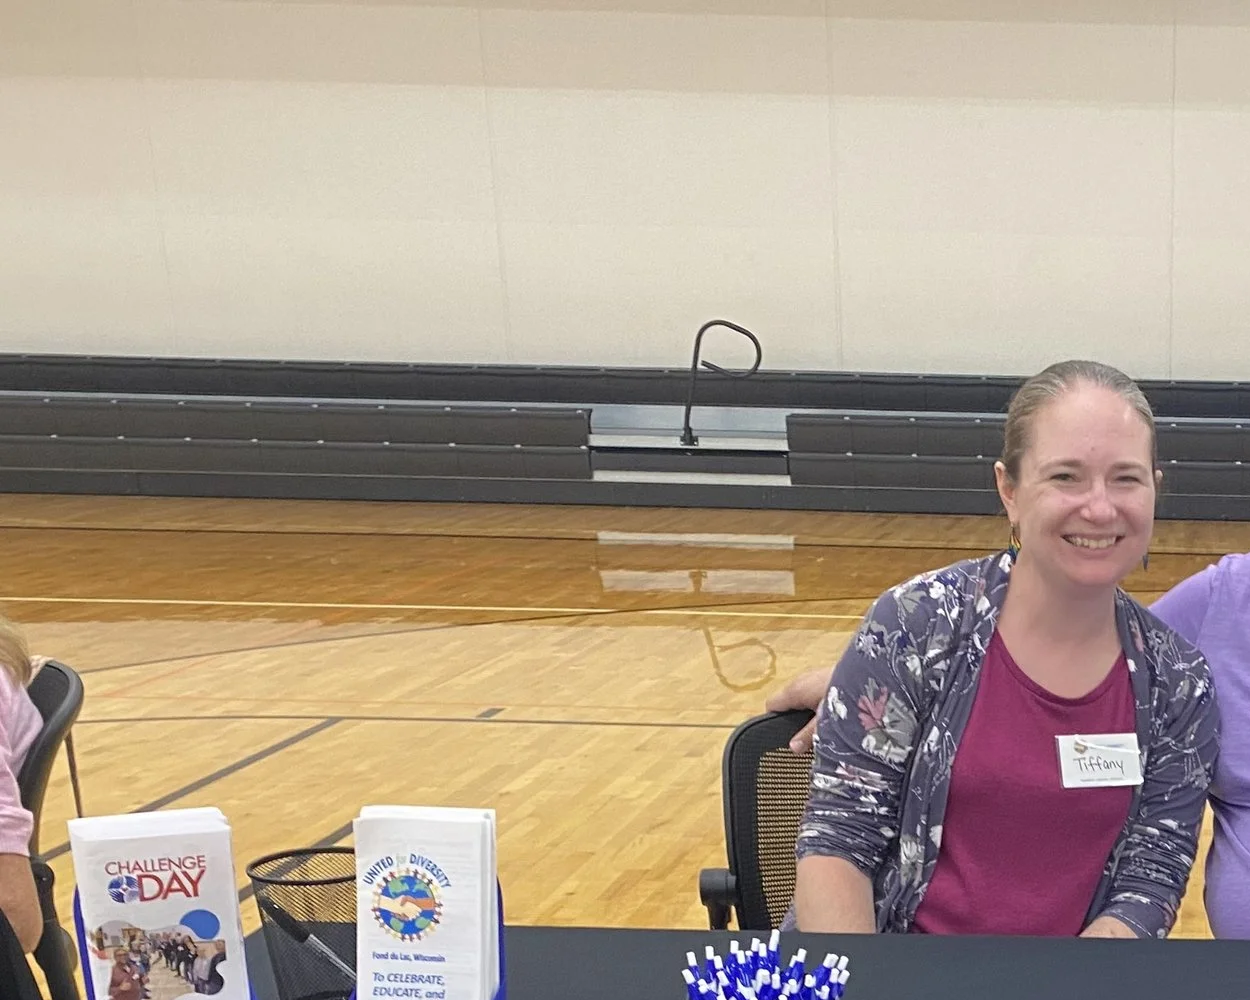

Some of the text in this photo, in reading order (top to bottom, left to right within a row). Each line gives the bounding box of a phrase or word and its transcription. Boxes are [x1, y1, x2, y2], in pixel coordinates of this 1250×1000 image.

[1073, 755, 1125, 776] Tiffany
[105, 855, 206, 876] CHALLENGE
[363, 856, 394, 885] UNITED
[410, 853, 452, 888] DIVERSITY
[137, 869, 207, 902] DAY
[372, 952, 389, 960] Fond
[390, 952, 399, 960] du
[413, 954, 446, 962] Wisconsin
[373, 972, 446, 986] To CELEBRATE,
[372, 986, 446, 999] EDUCATE, and
